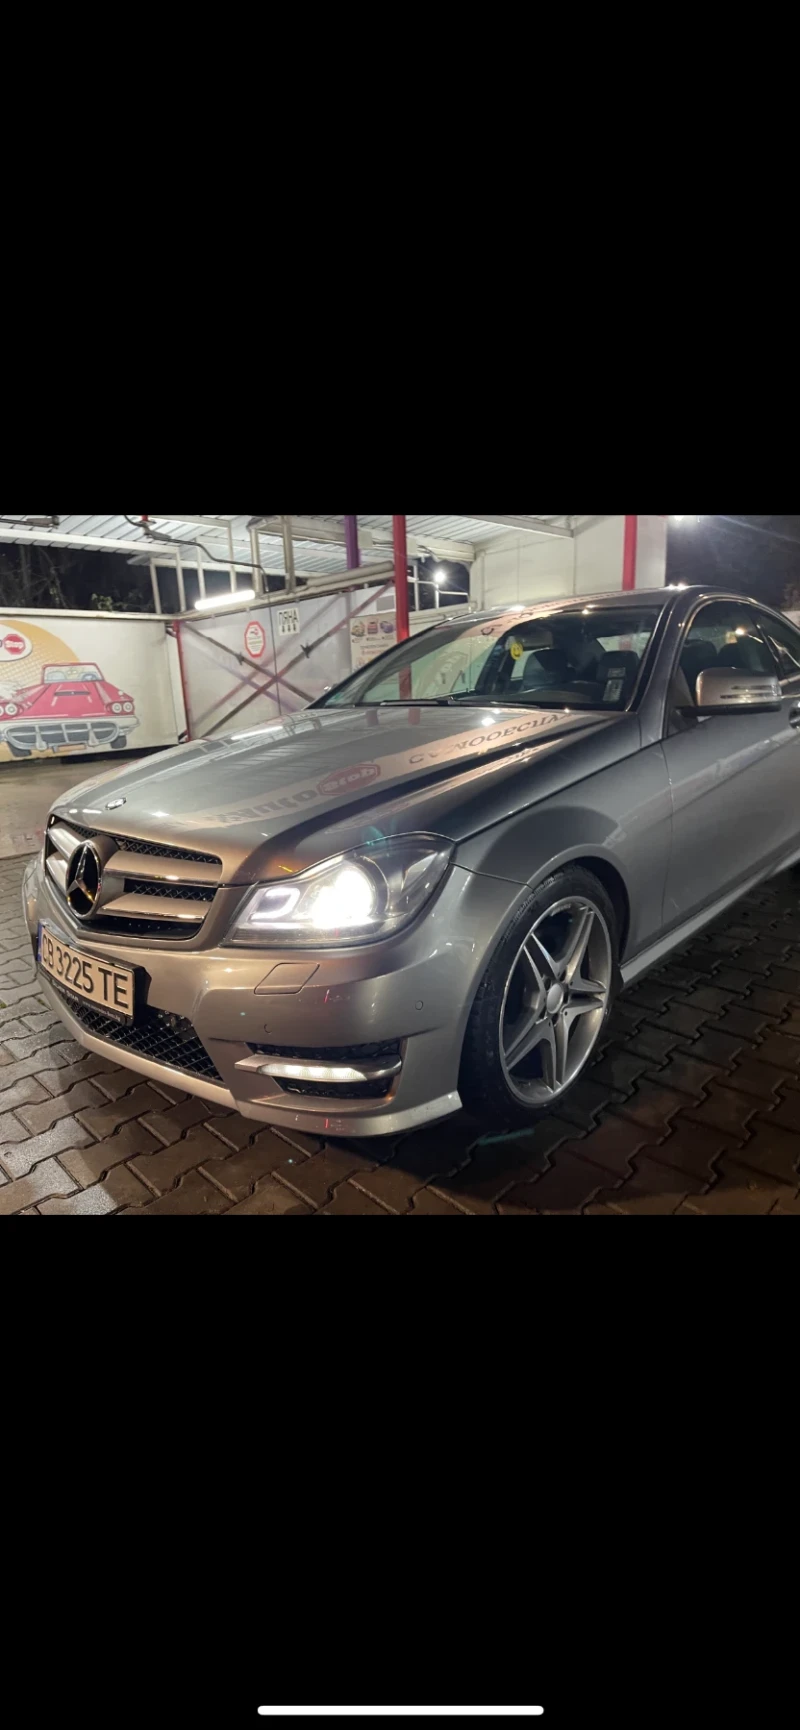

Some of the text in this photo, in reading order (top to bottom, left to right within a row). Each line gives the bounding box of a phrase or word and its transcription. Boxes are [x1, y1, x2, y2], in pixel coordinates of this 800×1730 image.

[42, 933, 129, 1009] CB 3225 TE
